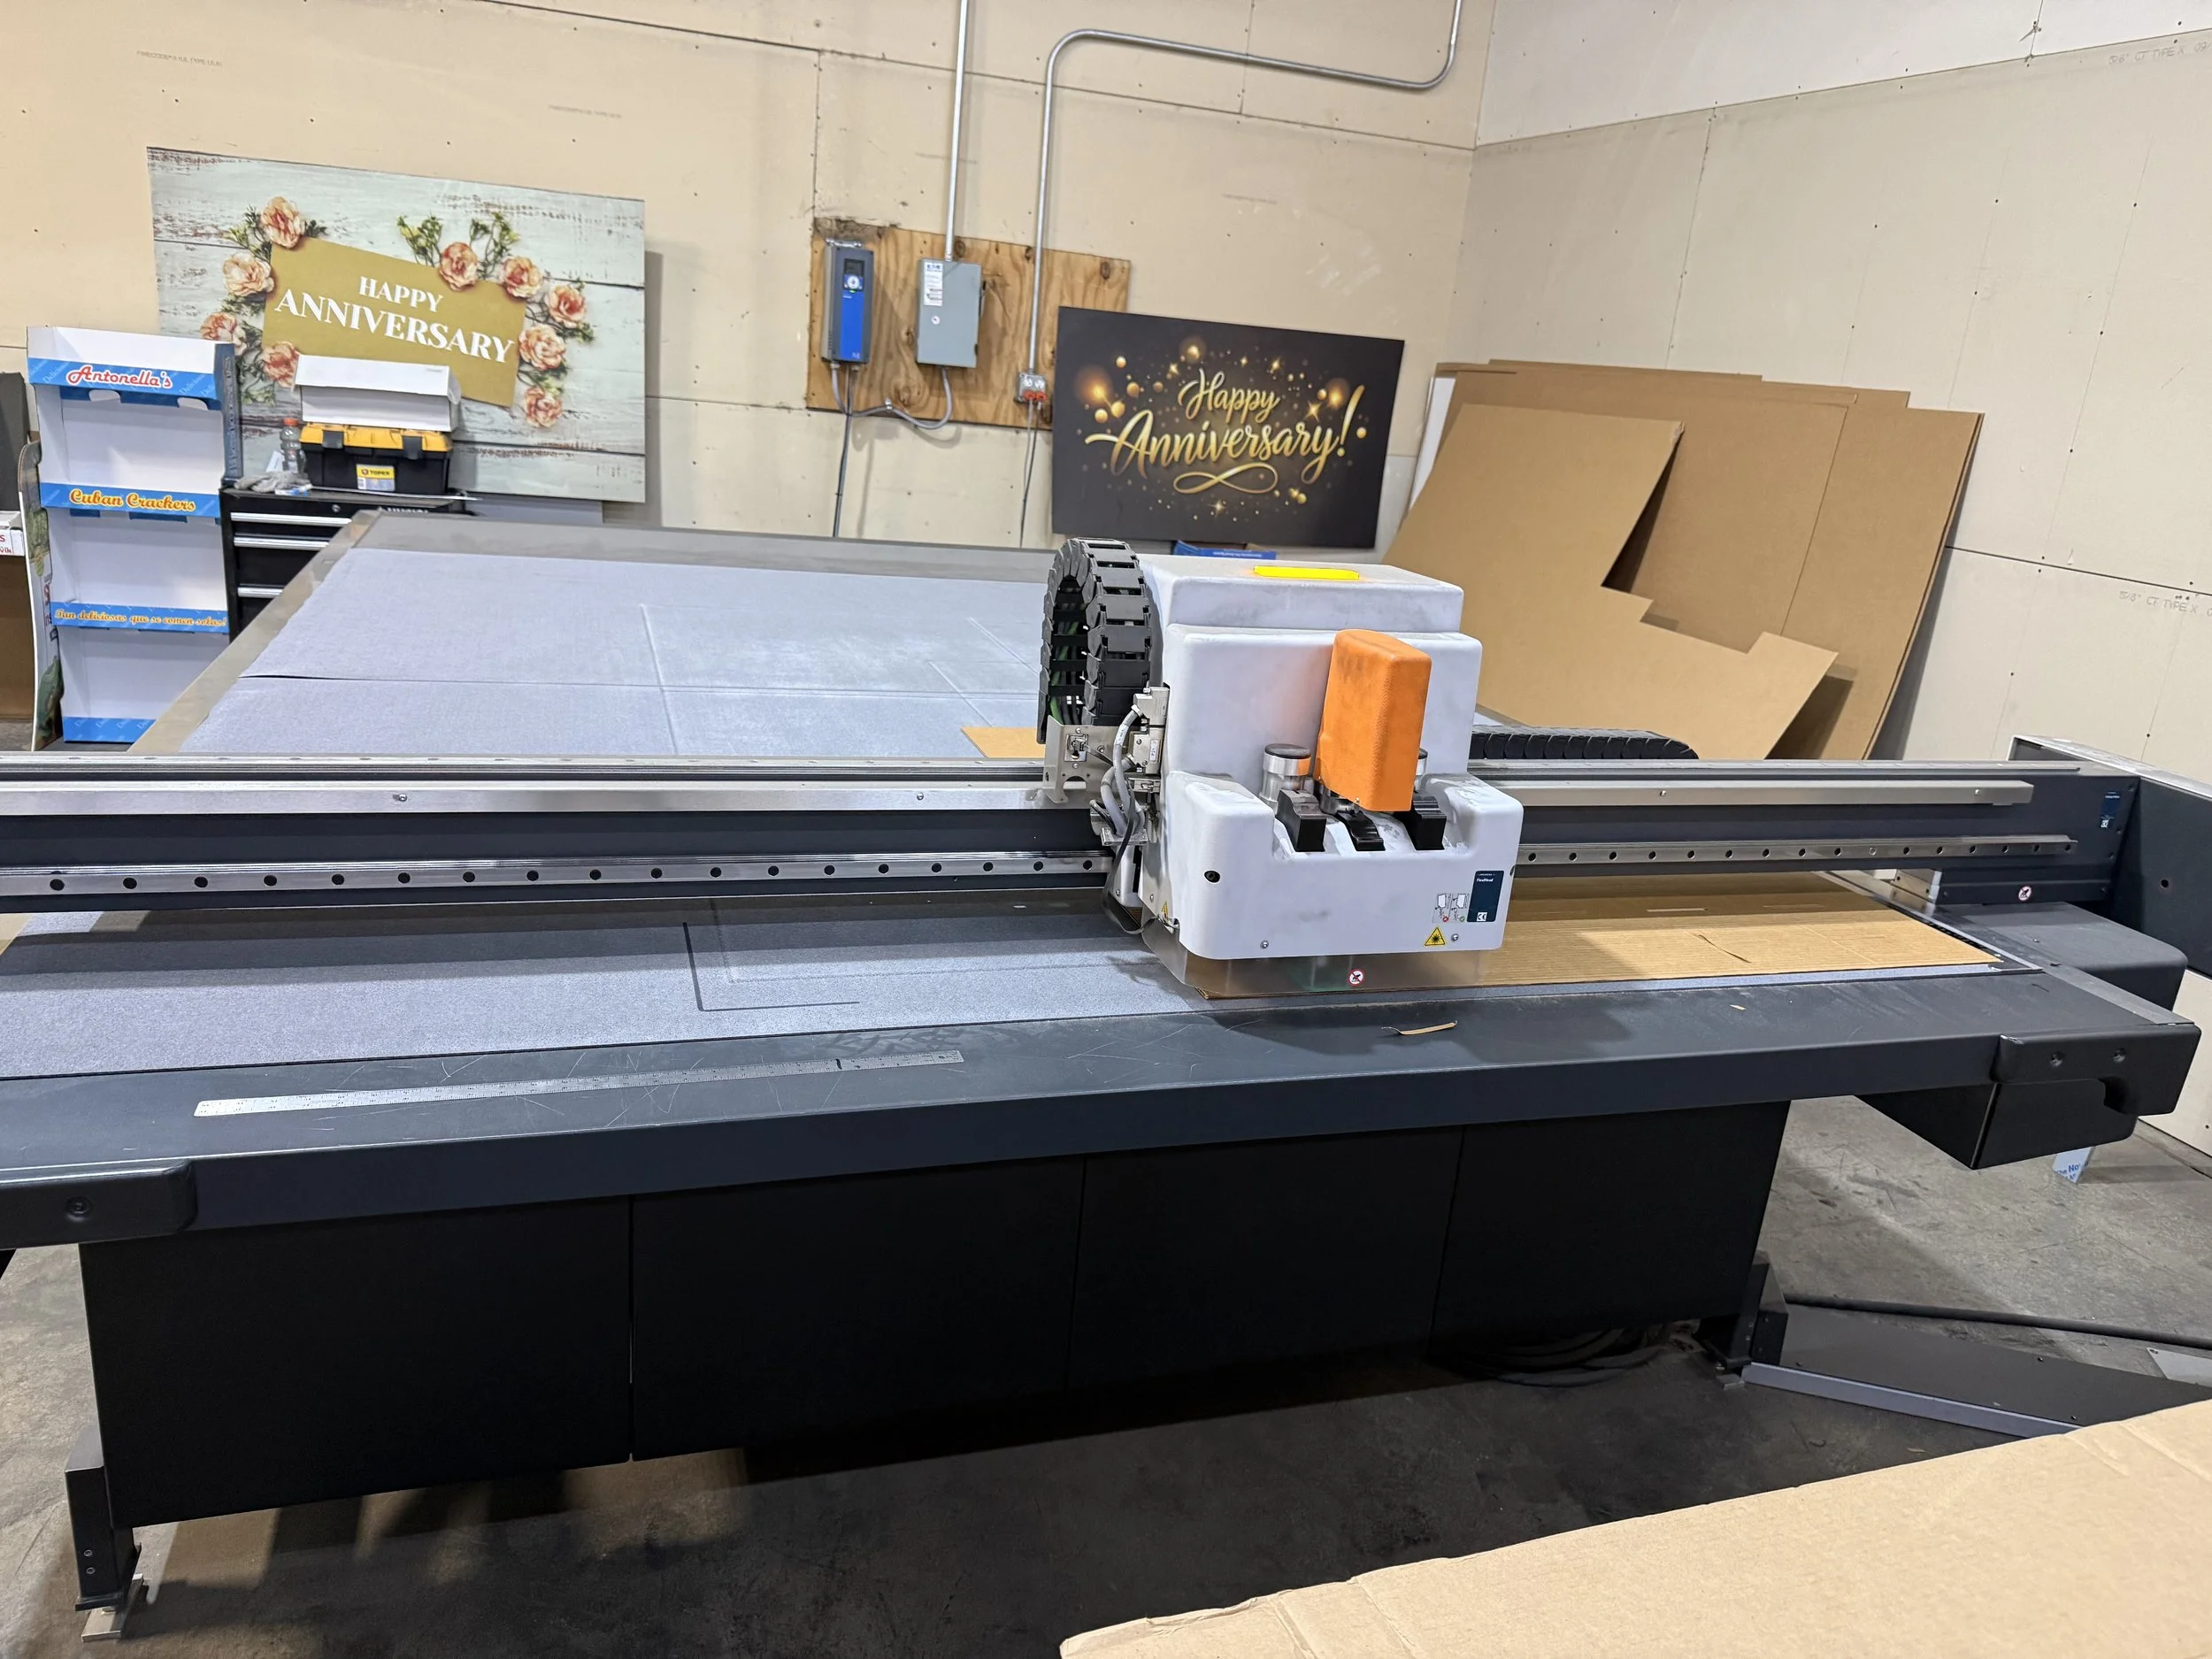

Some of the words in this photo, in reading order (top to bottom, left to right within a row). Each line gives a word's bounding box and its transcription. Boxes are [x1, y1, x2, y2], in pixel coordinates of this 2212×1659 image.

[359, 276, 444, 312] HAPPY
[274, 288, 516, 364] ANNIVERSARY
[66, 365, 173, 389] Antonella's
[1178, 367, 1281, 424] Happy
[1085, 384, 1365, 485] Anniversary!
[69, 488, 125, 507] Cuban
[126, 492, 196, 512] Crackers
